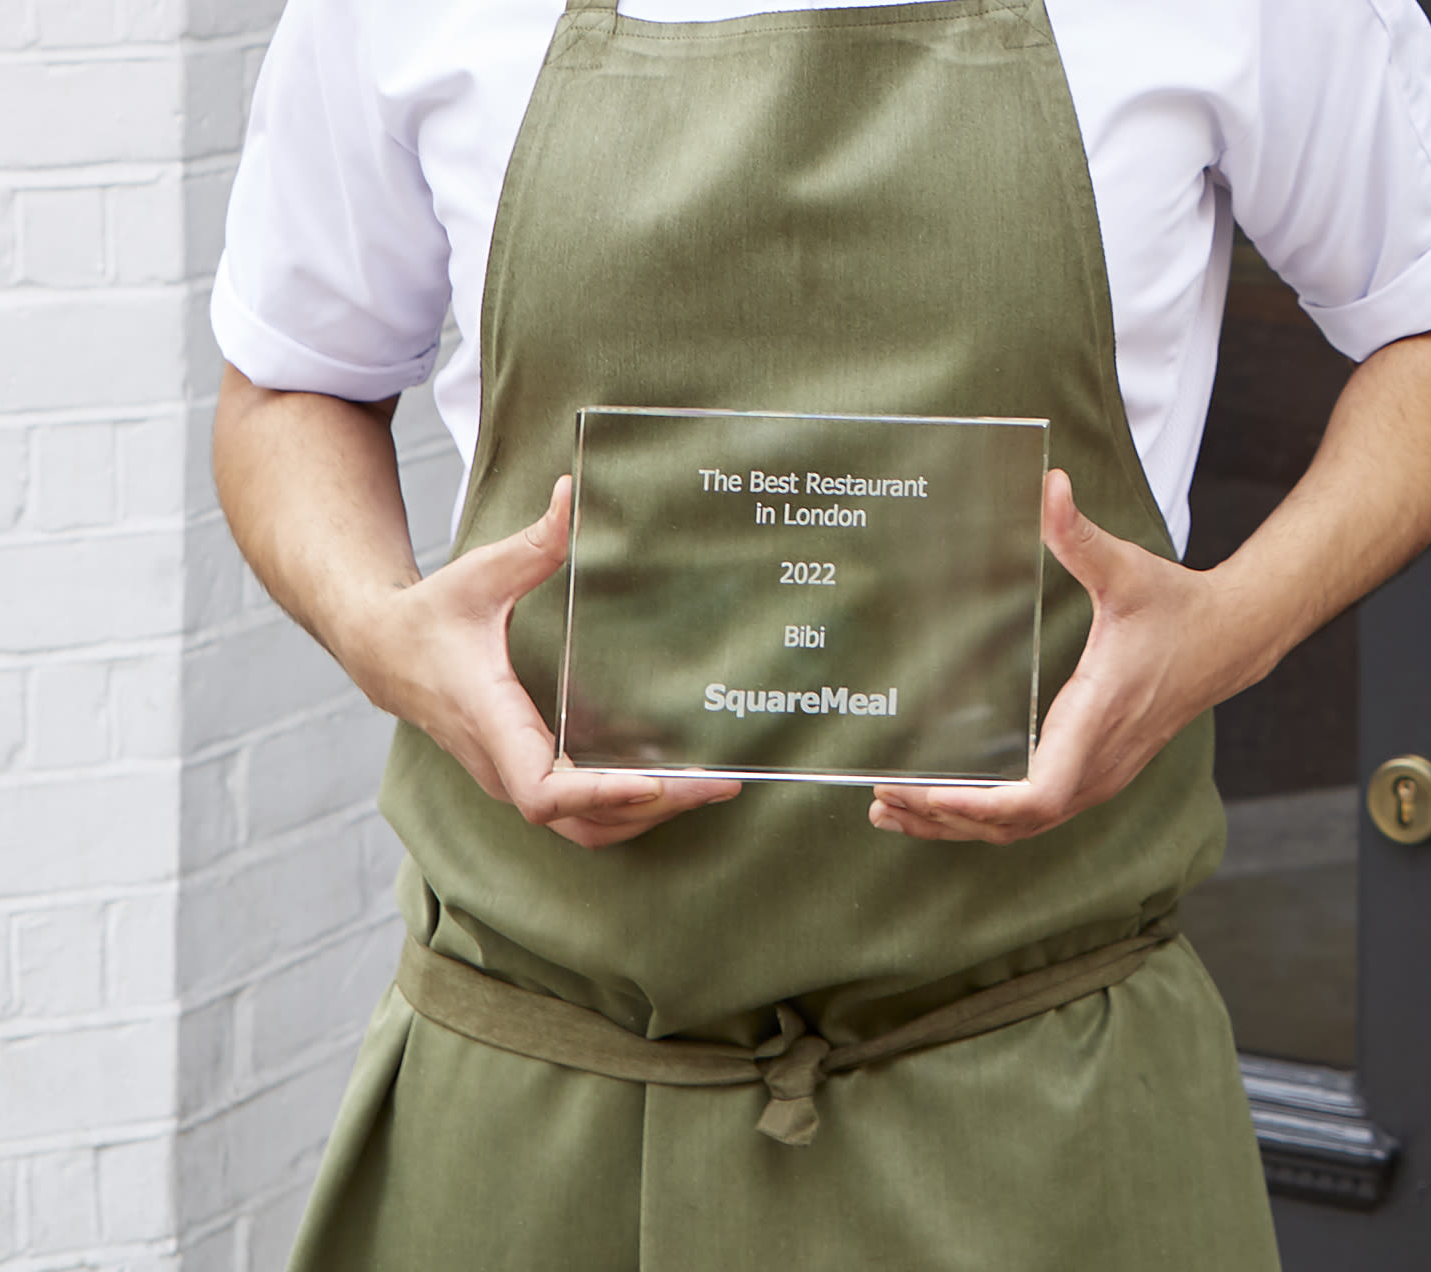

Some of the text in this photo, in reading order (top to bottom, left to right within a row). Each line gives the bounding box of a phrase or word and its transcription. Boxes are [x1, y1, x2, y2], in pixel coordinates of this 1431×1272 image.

[699, 469, 928, 498] The Best Restaurant
[756, 503, 867, 527] in London
[779, 562, 836, 585] 2022
[784, 625, 825, 648] Bibi
[704, 683, 898, 717] SquareMeal
